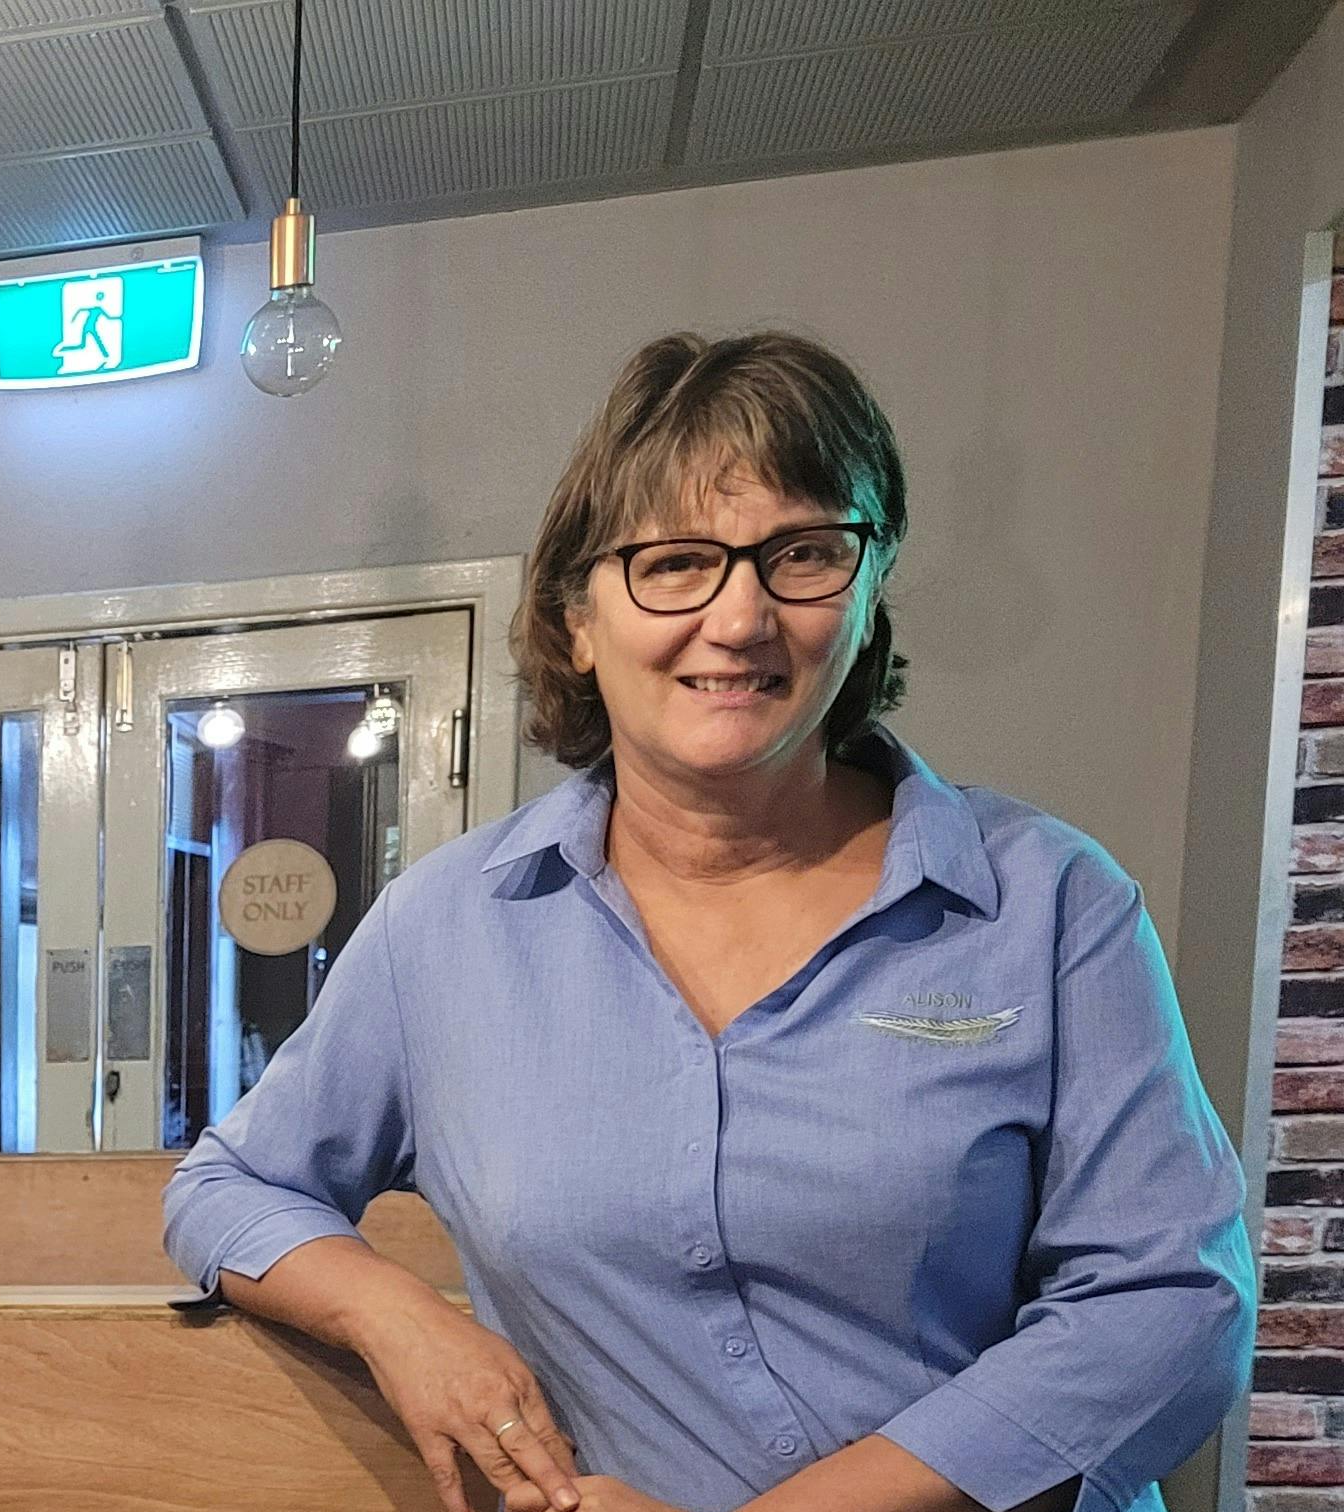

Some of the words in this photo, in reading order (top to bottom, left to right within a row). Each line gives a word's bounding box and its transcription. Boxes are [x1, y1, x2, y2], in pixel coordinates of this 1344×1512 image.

[242, 872, 312, 896] STAFF
[242, 901, 309, 921] ONLY
[52, 961, 85, 974] PUSH
[902, 991, 973, 1009] ALISON
